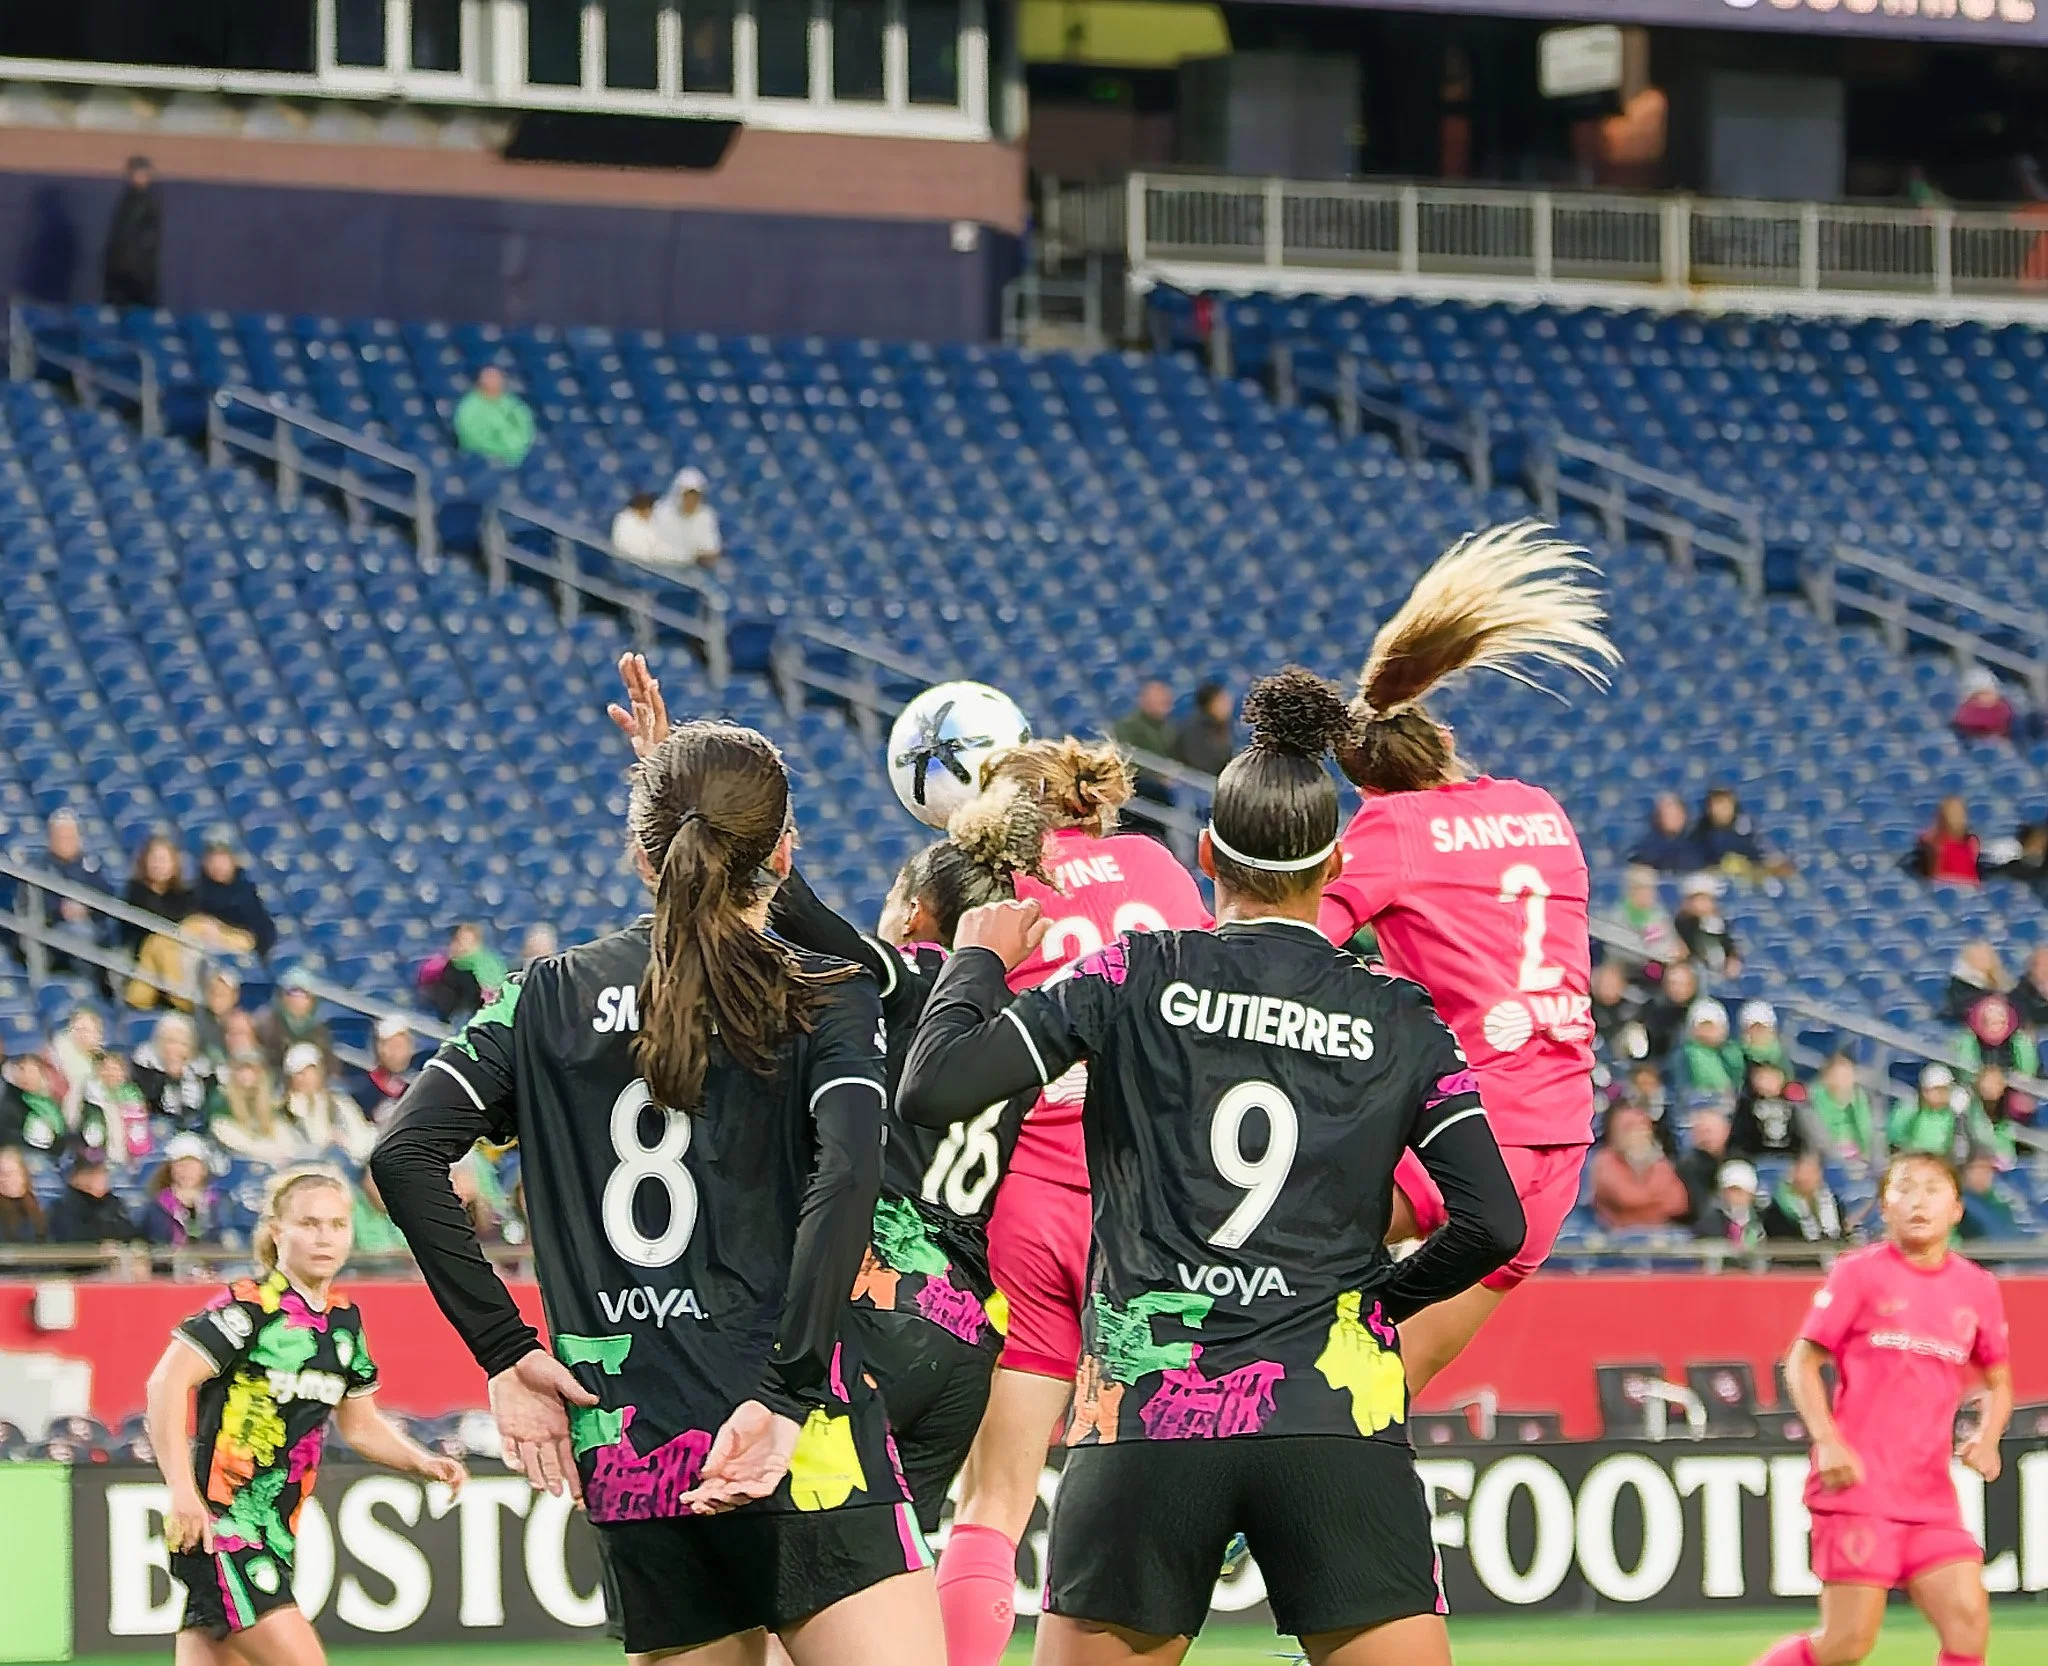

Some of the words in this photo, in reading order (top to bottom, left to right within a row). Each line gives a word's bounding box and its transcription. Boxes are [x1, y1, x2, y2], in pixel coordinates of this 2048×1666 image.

[1430, 813, 1571, 853] SANCHEZ
[1499, 863, 1566, 992] 2
[1160, 980, 1375, 1061] GUTIERRES
[602, 1077, 698, 1268] 8
[921, 1100, 1009, 1216] 16
[1207, 1079, 1299, 1249] 9
